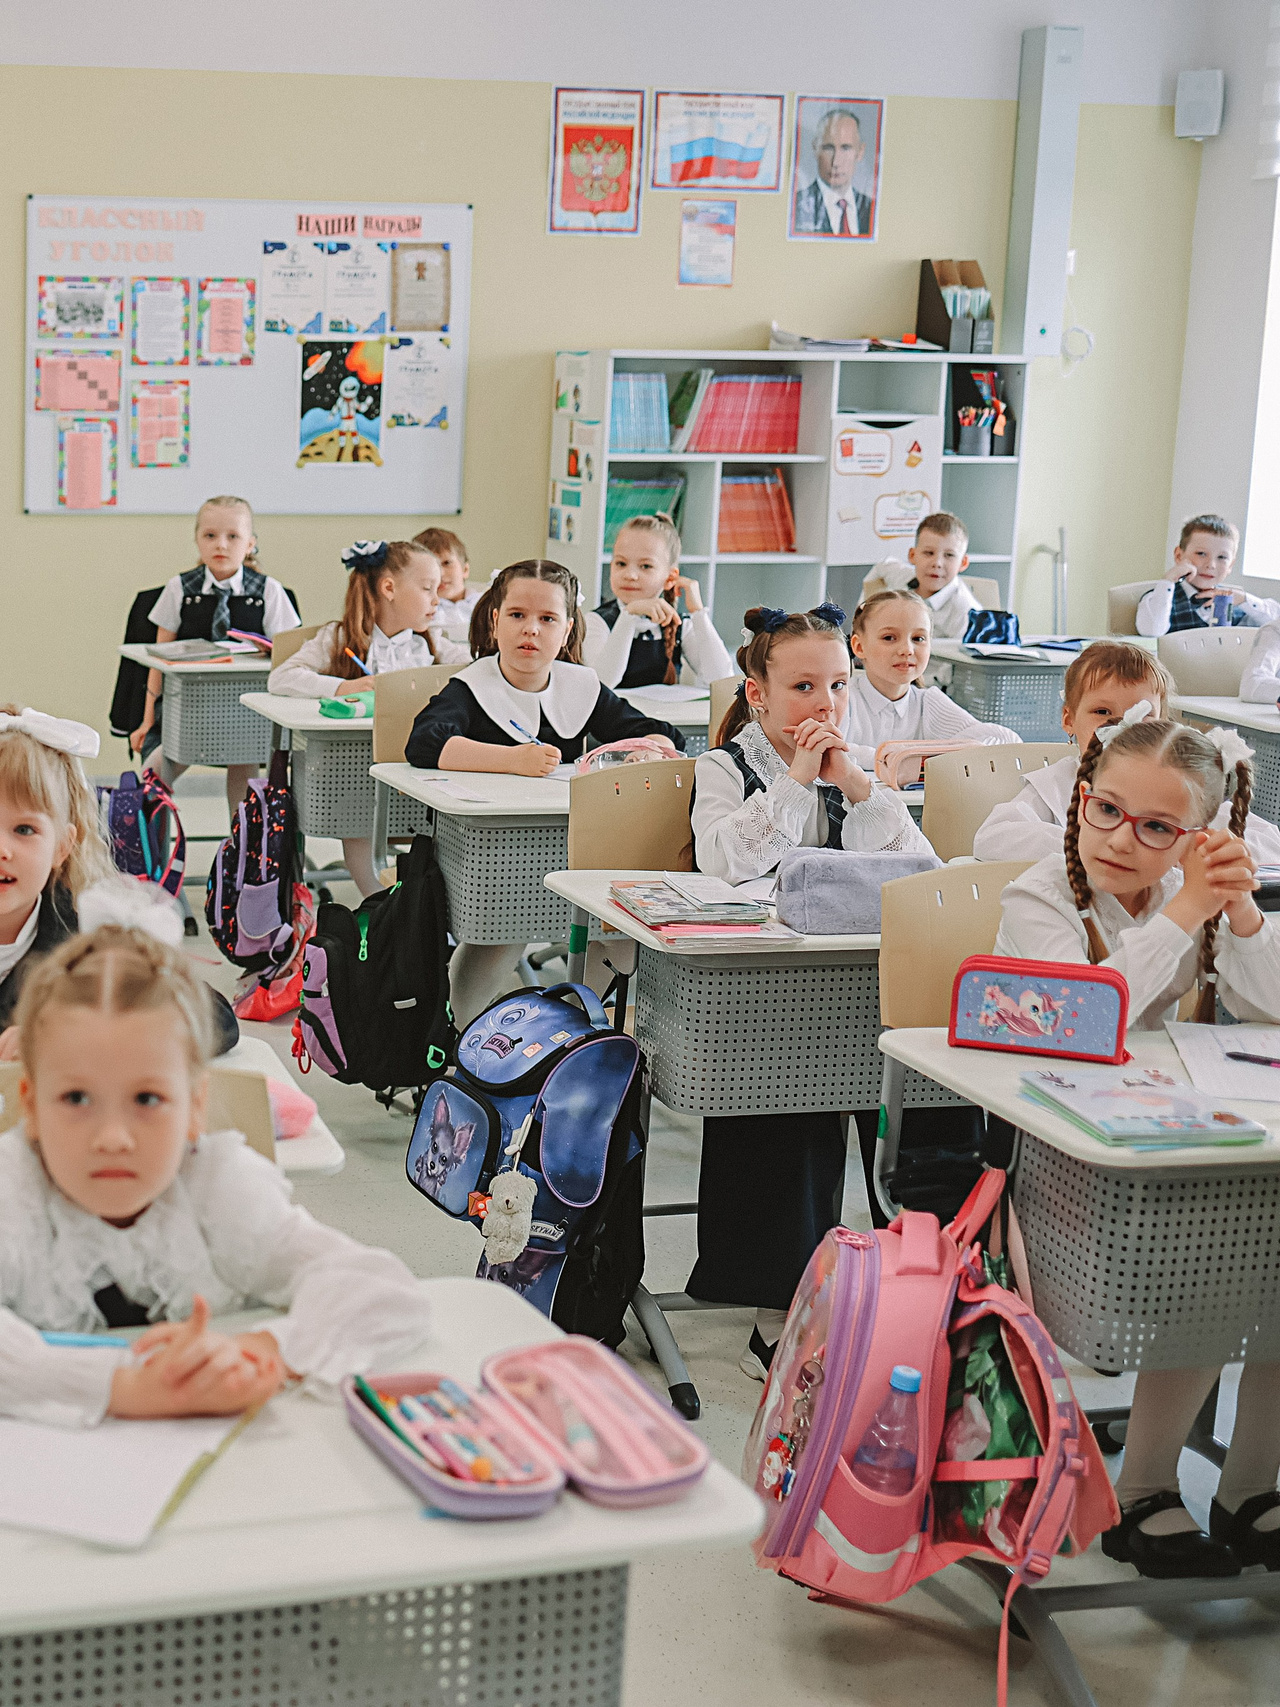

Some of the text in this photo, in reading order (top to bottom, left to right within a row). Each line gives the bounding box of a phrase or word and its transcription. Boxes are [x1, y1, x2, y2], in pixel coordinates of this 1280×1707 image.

[38, 207, 205, 231] КЛАССНЫЙ
[298, 214, 356, 236] НАШИ
[50, 240, 174, 262] УГОЛОК
